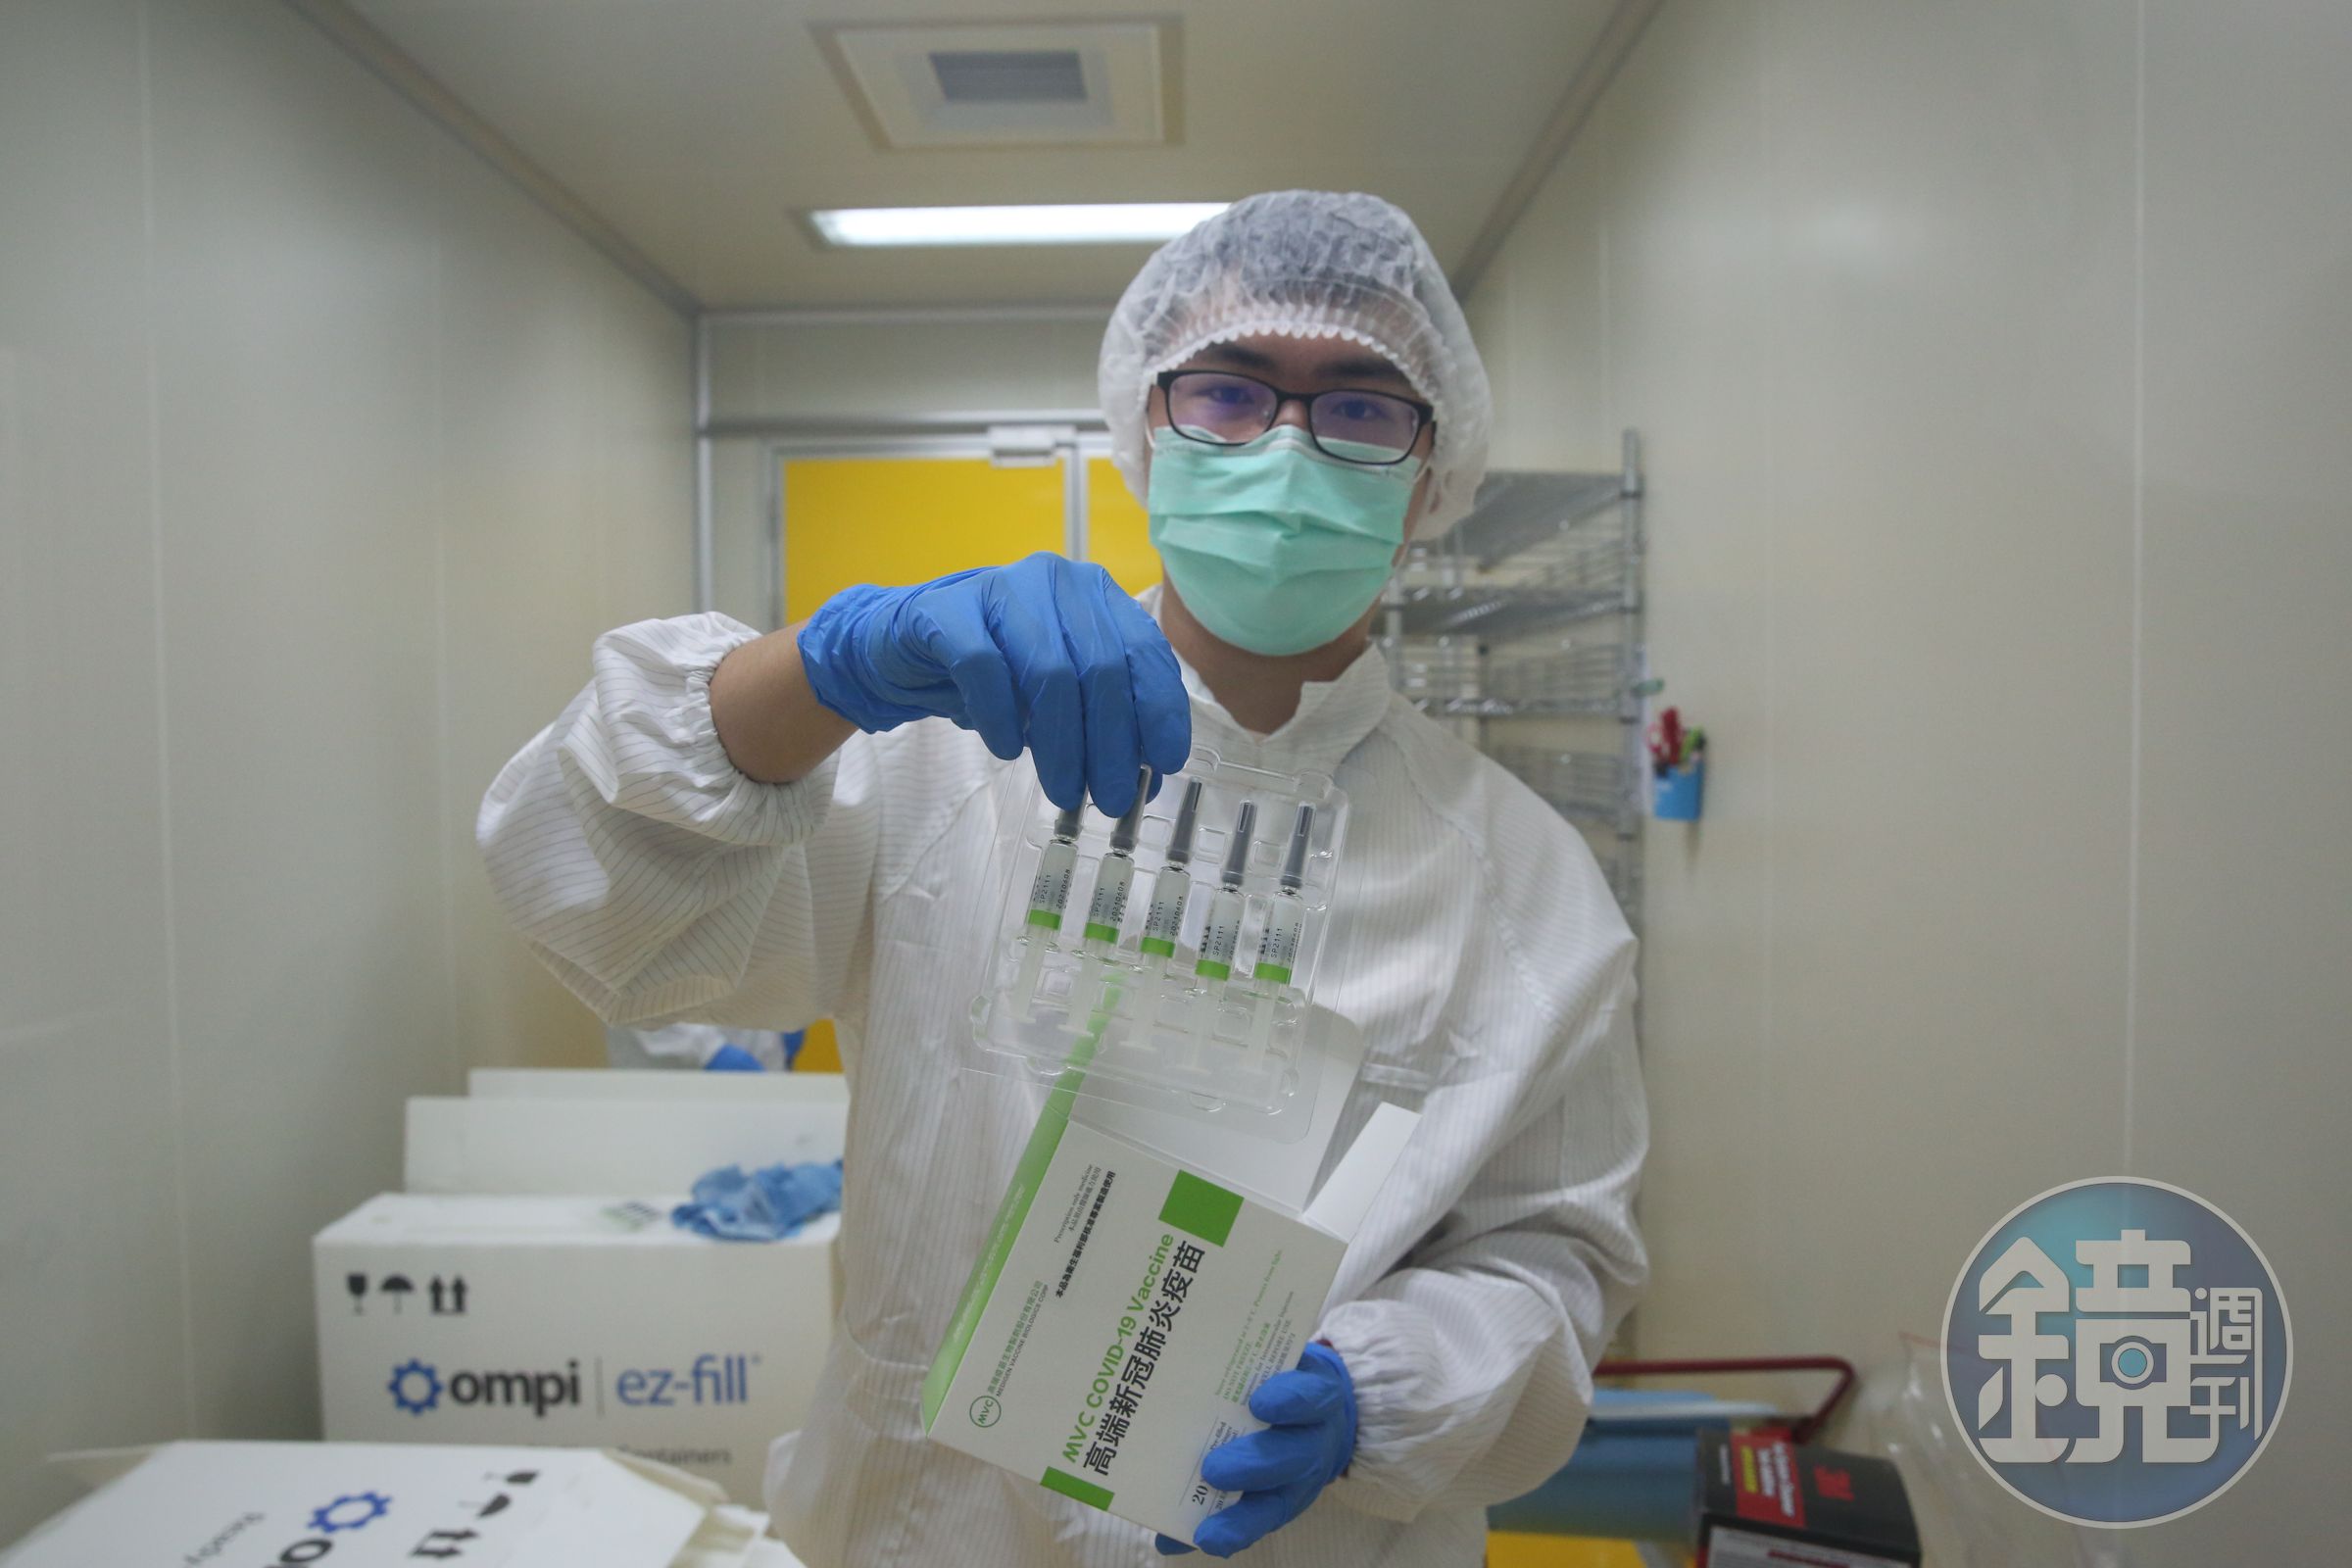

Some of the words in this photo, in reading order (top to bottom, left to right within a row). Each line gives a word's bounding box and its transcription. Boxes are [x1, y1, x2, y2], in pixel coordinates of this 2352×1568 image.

[1039, 874, 1051, 904] SP2111
[1056, 869, 1070, 909] 20210608
[1093, 887, 1104, 917] SP2111
[1110, 881, 1125, 921] 20210608
[1152, 902, 1164, 931] SP2111
[1213, 925, 1224, 956] SP2111
[1271, 928, 1283, 957] SP2111
[1053, 1204, 1075, 1243] Prescription
[1070, 1191, 1081, 1205] only
[1076, 1163, 1093, 1191] medicine
[996, 1367, 1012, 1396] MEDIGEN
[1008, 1339, 1025, 1366] VACCINE
[1022, 1302, 1041, 1338] BIOLOGICS
[1060, 1409, 1096, 1463] MVC
[1084, 1313, 1139, 1410] COVID-19
[1126, 1230, 1175, 1314] Vaccine
[1081, 1239, 1205, 1476] 高端新冠肺炎疫苗
[450, 1359, 580, 1417] ompi
[977, 1398, 994, 1424] MVC
[1191, 1483, 1209, 1505] 20
